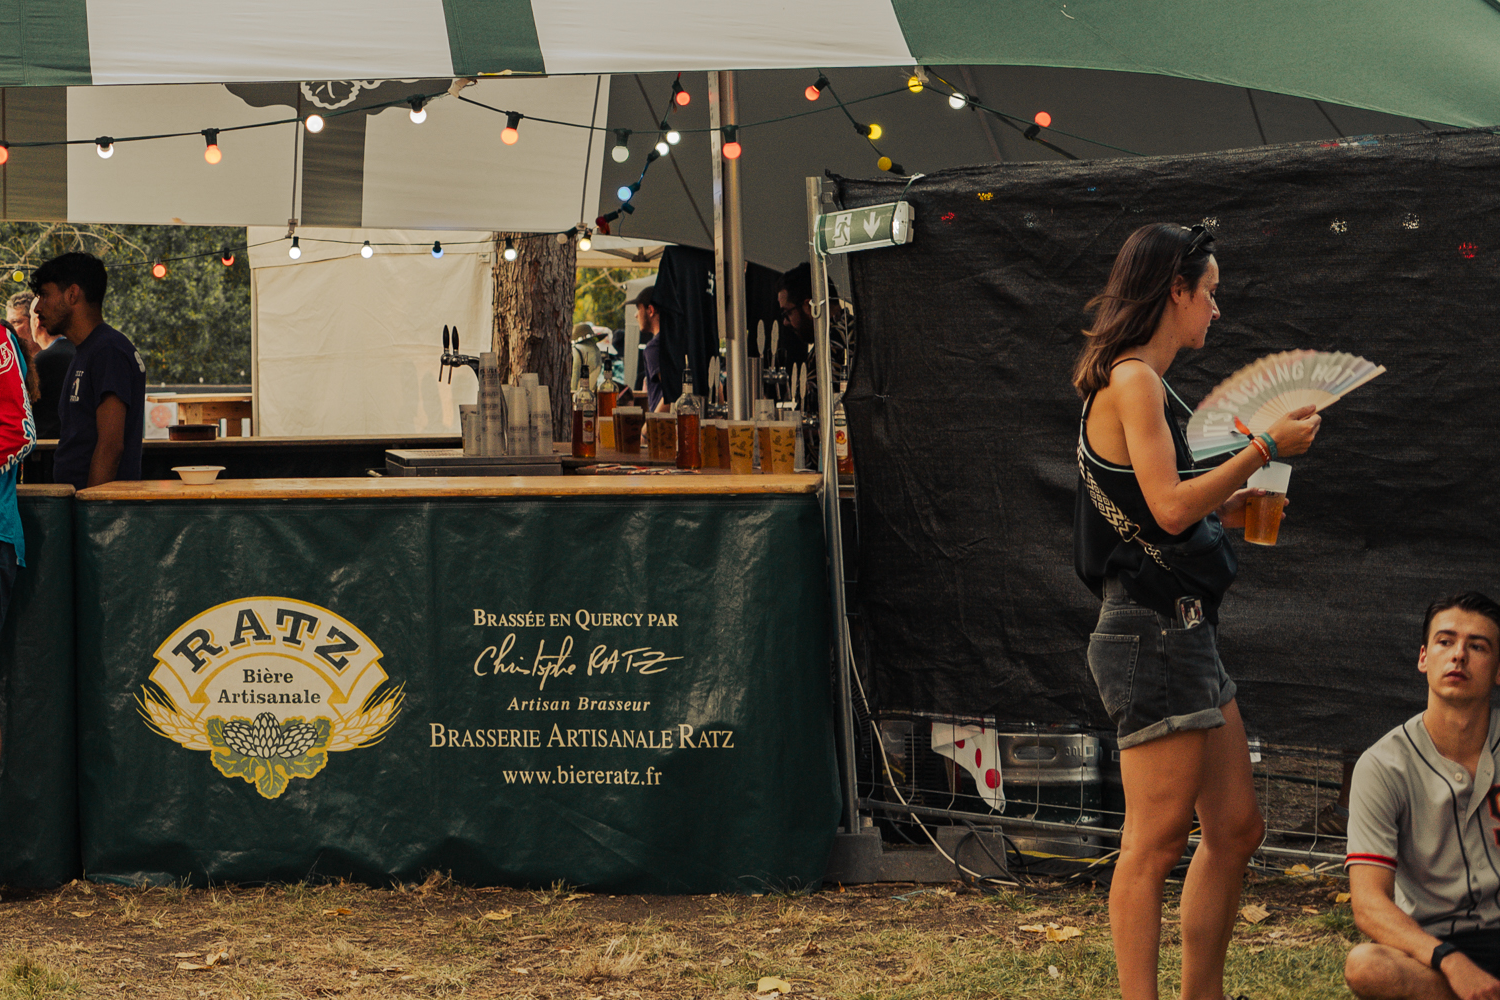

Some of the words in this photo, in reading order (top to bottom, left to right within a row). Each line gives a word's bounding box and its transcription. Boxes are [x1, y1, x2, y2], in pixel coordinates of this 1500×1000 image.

[473, 607, 547, 628] BRASSÉE
[550, 612, 571, 627] EN
[575, 608, 644, 631] QUERCY
[647, 613, 678, 628] PAR
[171, 607, 364, 673] RATZ
[586, 645, 684, 677] RATZ
[242, 666, 294, 684] Bière
[217, 687, 321, 705] Artisanale
[507, 696, 571, 711] Artisan
[577, 696, 651, 711] Brasseur
[429, 721, 542, 749] BRASSERIE
[546, 720, 674, 749] ARTISANALE
[678, 722, 735, 749] RATZ
[502, 764, 663, 787] www.biereratz.fr
